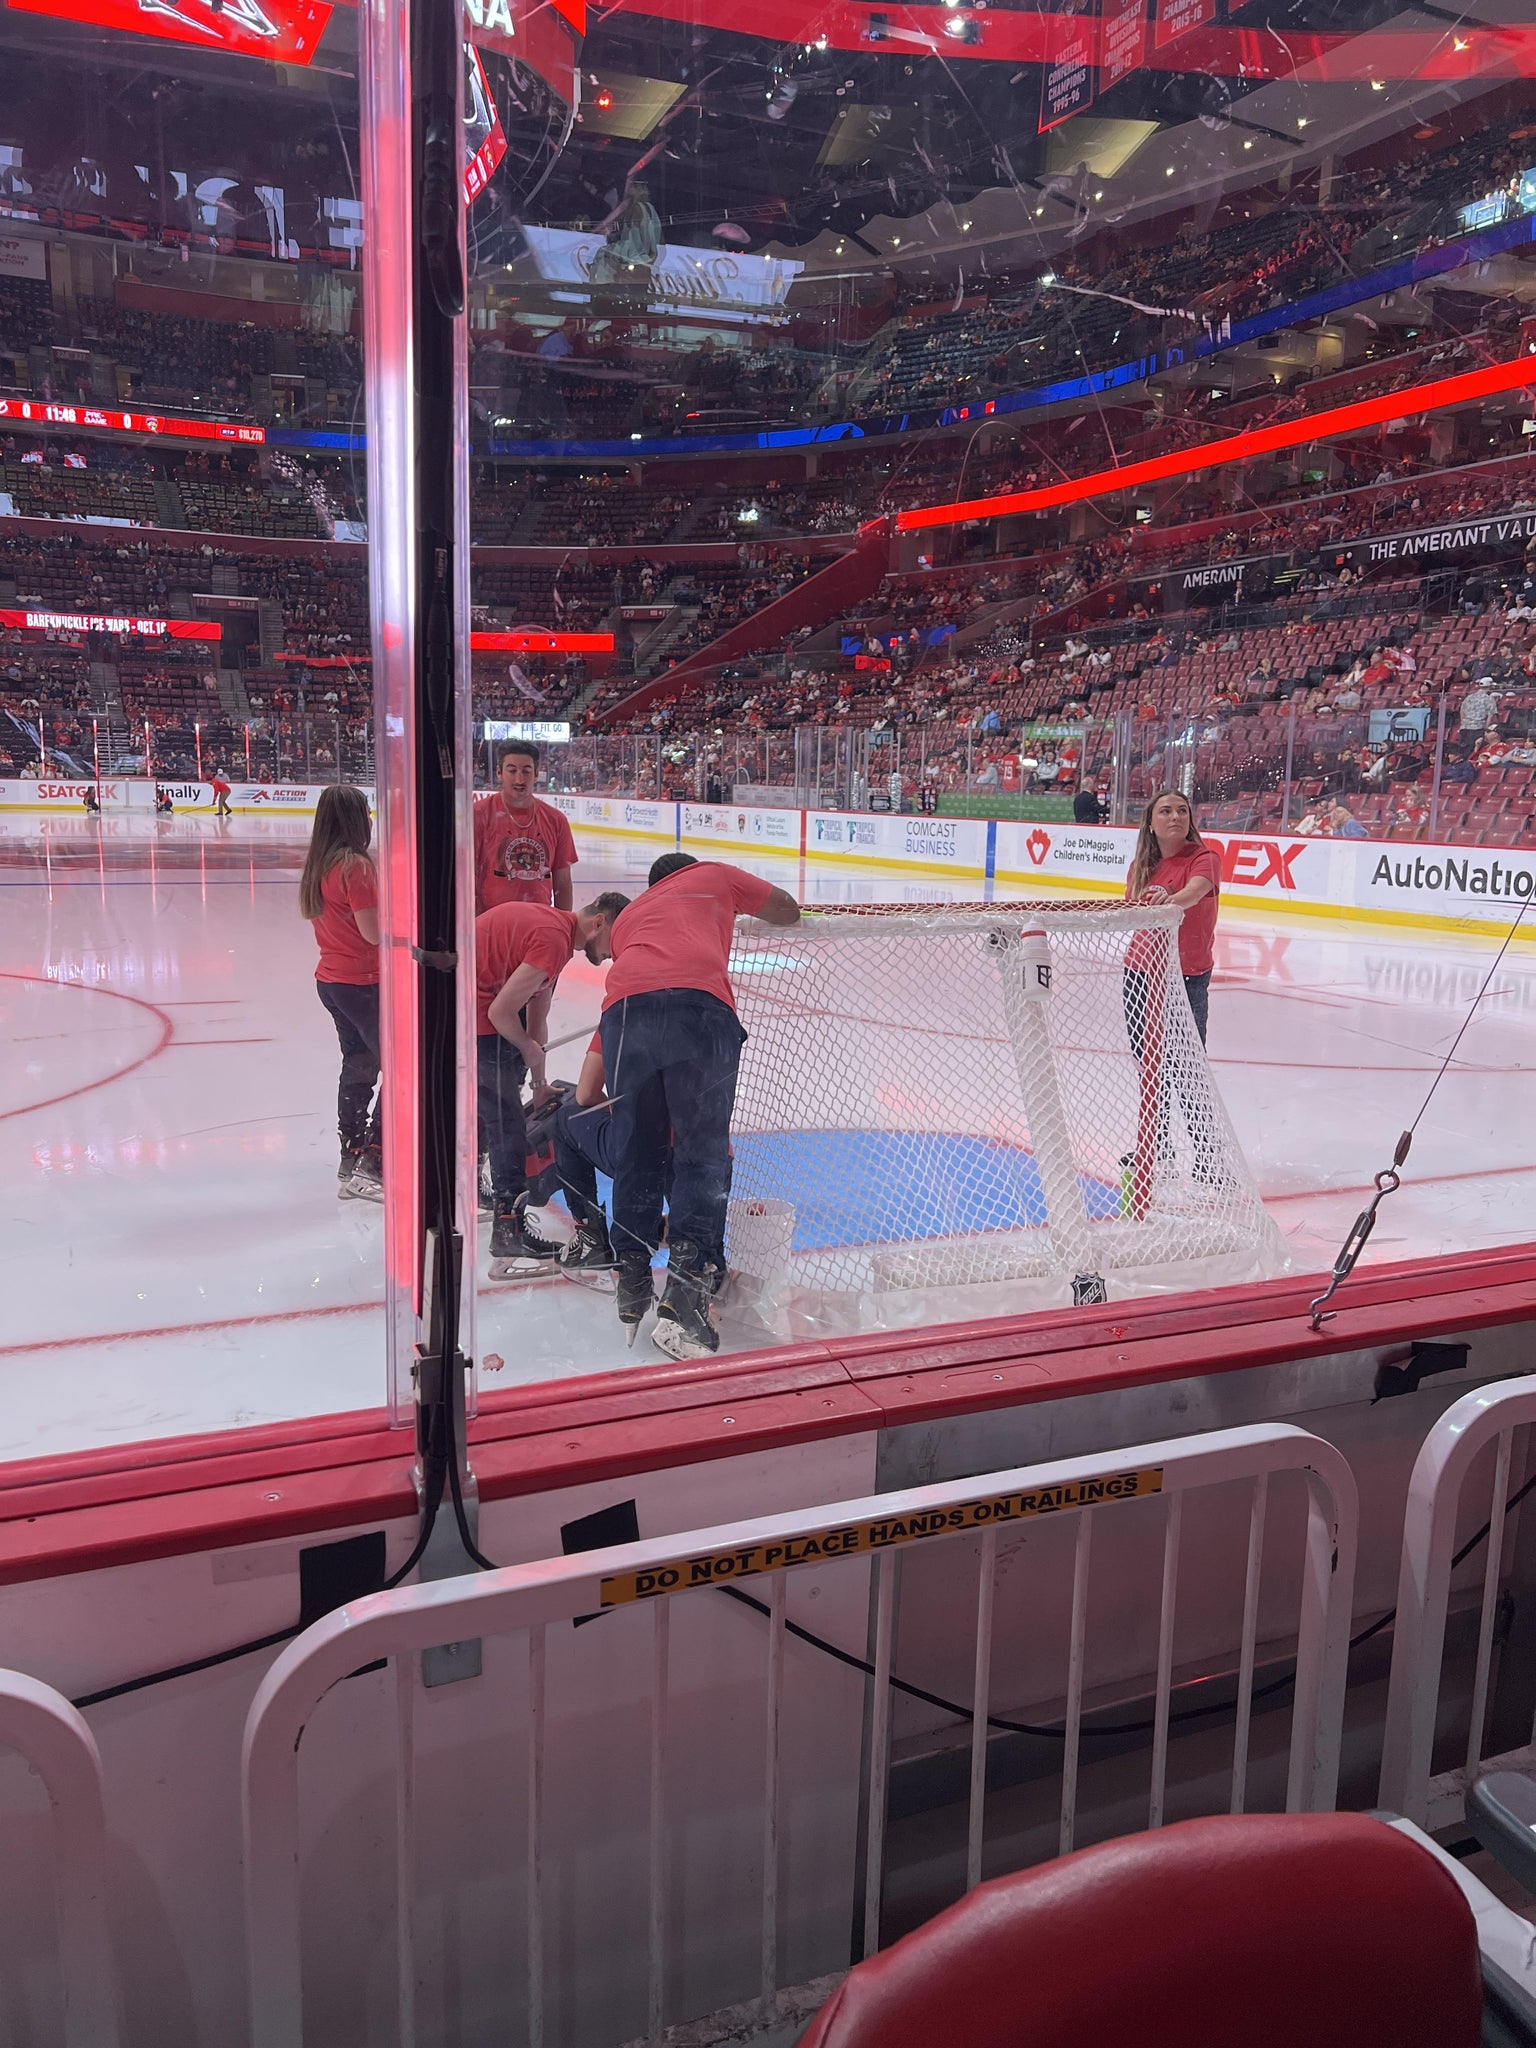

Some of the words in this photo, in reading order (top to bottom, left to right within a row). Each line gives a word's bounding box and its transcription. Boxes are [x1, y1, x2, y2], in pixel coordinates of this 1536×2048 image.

[1171, 4, 1202, 34] 2015-16
[1055, 38, 1083, 67] EASTERN
[1048, 50, 1088, 86] CONFERENCE
[1048, 68, 1086, 101] CHAMPIONS
[1053, 88, 1080, 114] 1995-96
[22, 402, 31, 419] 0
[46, 406, 76, 423] 11:48
[84, 417, 107, 425] GAME
[123, 414, 131, 430] 0
[1369, 540, 1398, 561] THE
[1401, 525, 1491, 556] AMERANT
[1183, 565, 1245, 588] AMERANT
[906, 821, 957, 838] COMCAST
[906, 839, 956, 856] BUSINESS
[1063, 838, 1077, 848] Joe
[1078, 839, 1115, 851] DiMaggio
[1054, 849, 1090, 862] Children's
[1092, 852, 1125, 865] Hospital
[1371, 854, 1536, 898] AutoNatio
[635, 1568, 680, 1594] DO
[691, 1550, 756, 1582] NOT
[765, 1532, 859, 1566] PLACE
[869, 1508, 964, 1544] HANDS
[973, 1496, 1011, 1523] ON
[1020, 1475, 1139, 1514] RAILINGS
